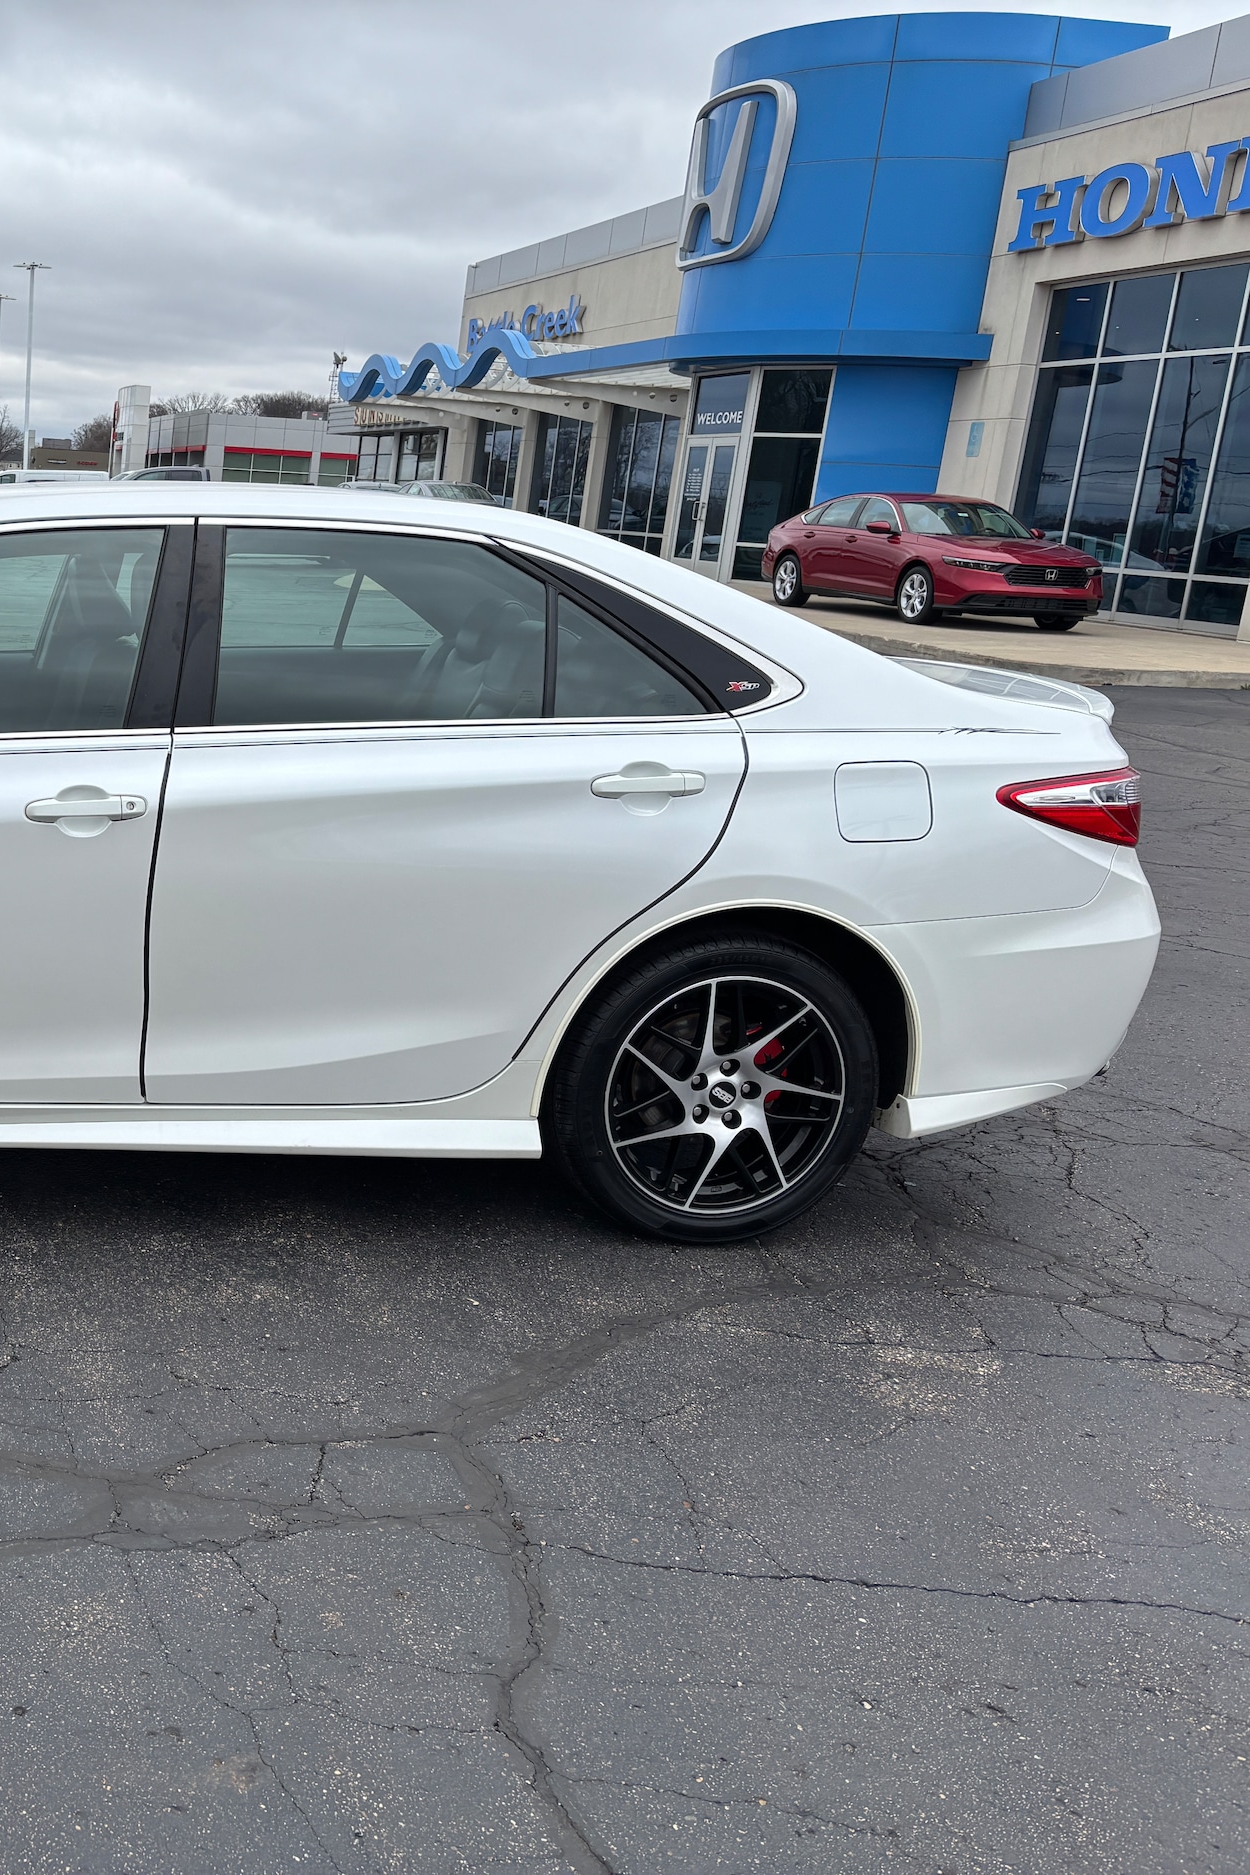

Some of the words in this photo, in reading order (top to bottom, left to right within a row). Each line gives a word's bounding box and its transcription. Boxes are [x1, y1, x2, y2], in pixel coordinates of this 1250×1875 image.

[1008, 136, 1250, 252] HON
[521, 294, 583, 341] Creek
[697, 411, 743, 425] WELCOME
[712, 1086, 734, 1104] BBS
